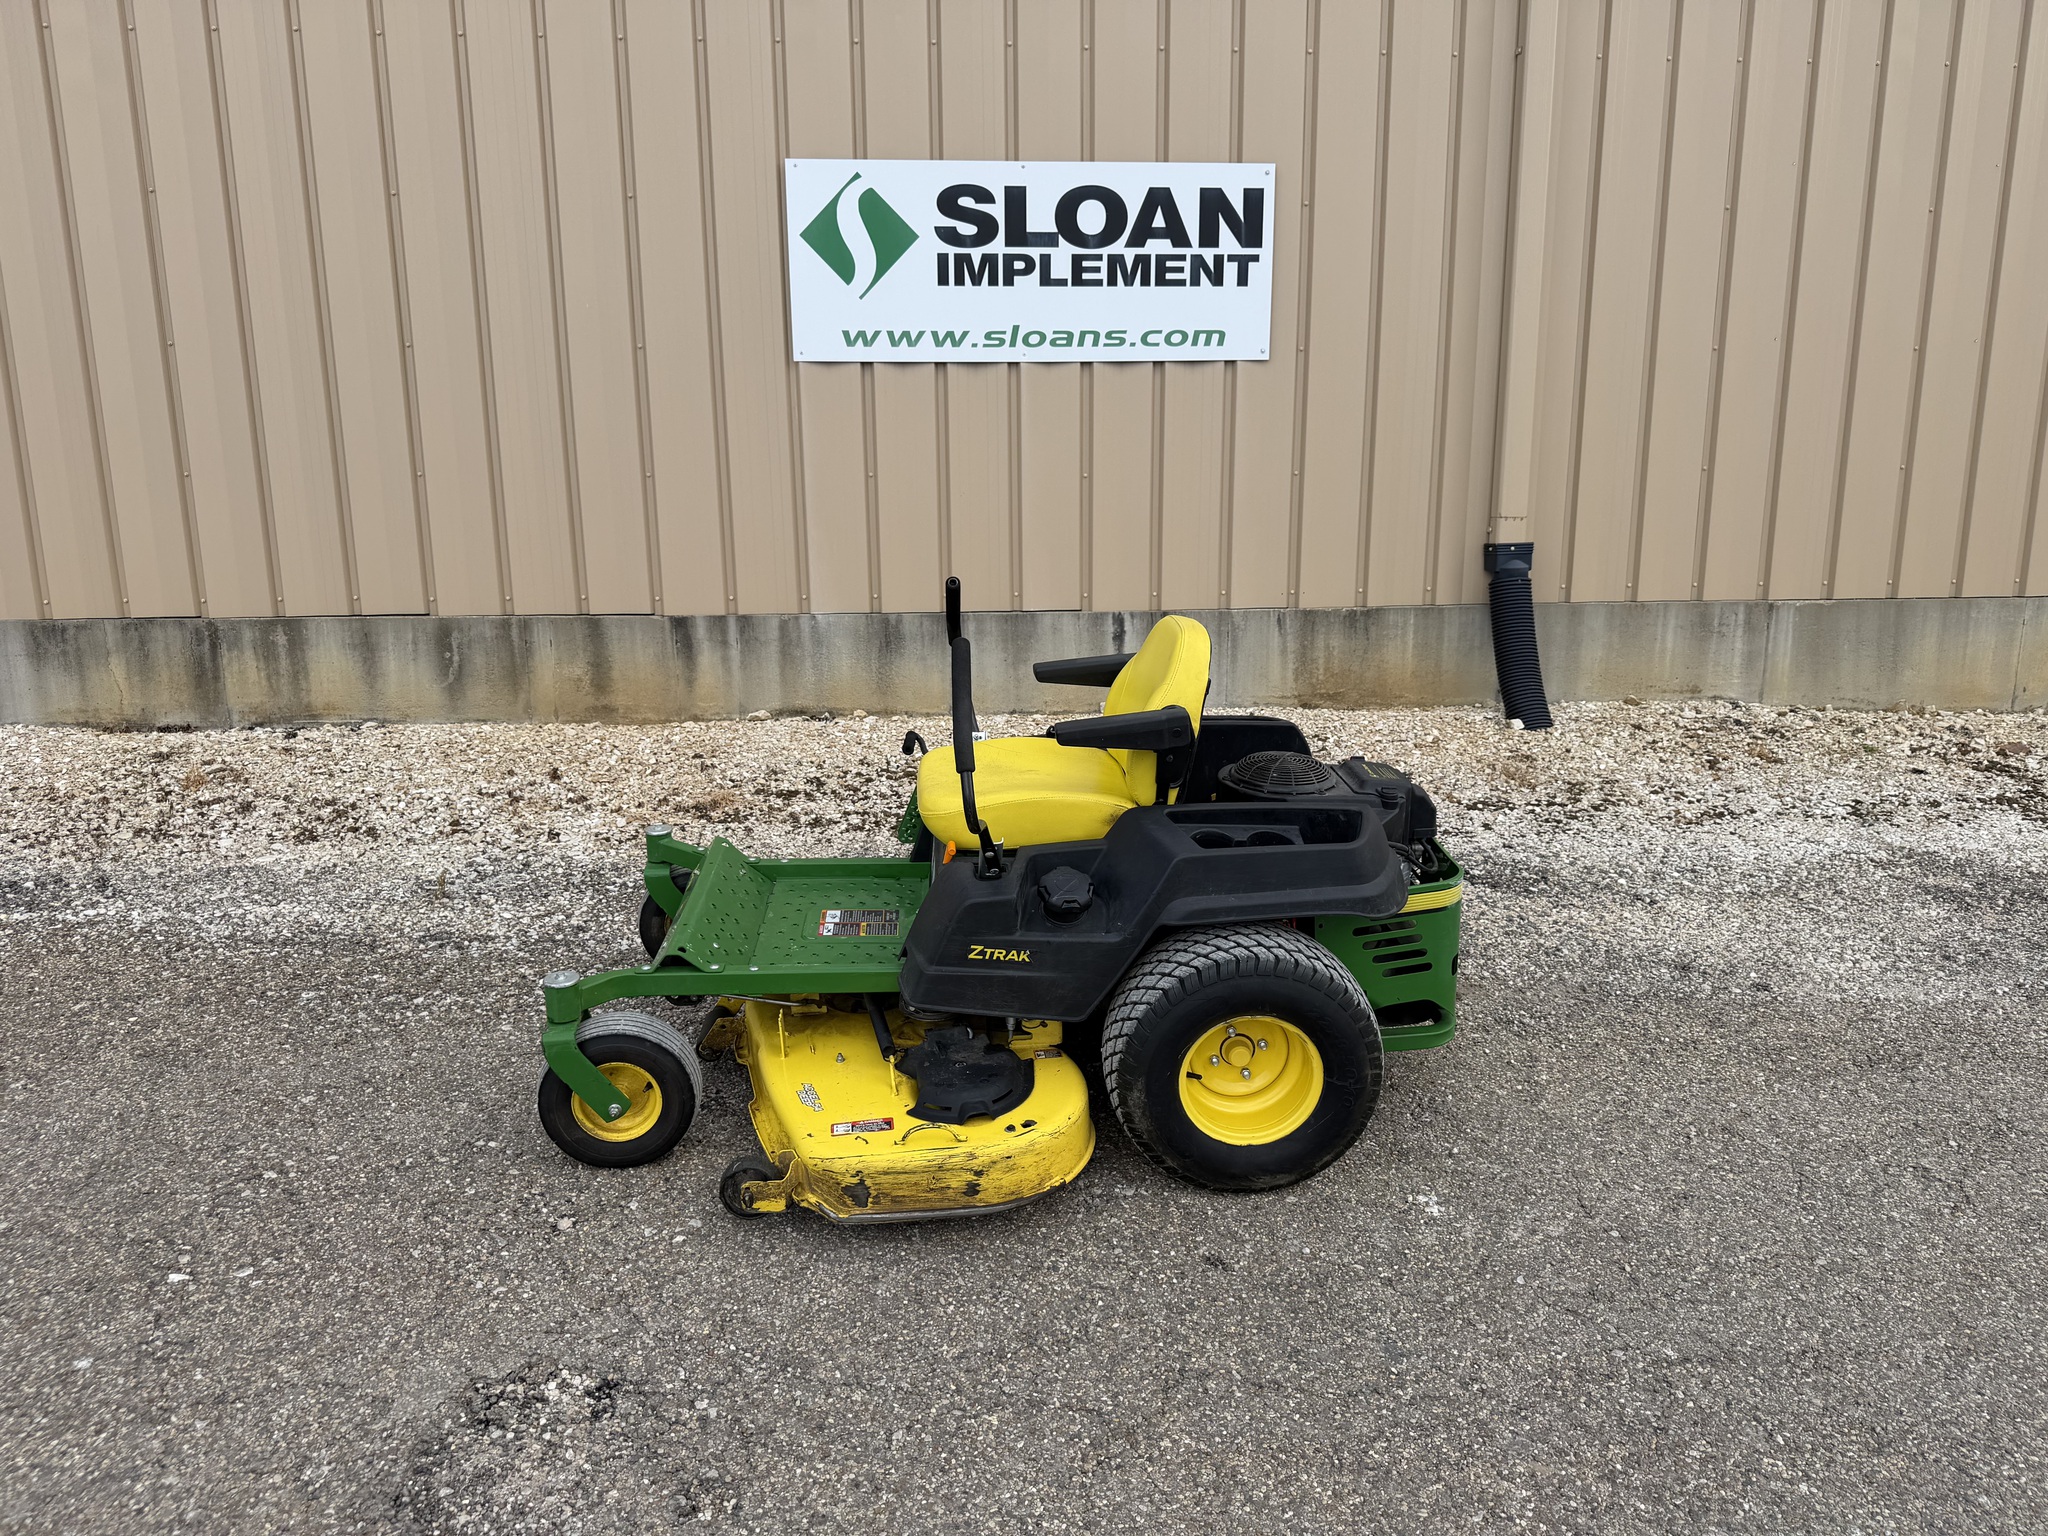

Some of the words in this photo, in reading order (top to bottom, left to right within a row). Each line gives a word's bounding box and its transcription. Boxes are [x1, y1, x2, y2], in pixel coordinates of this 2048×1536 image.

[934, 184, 1264, 249] SLOAN
[936, 253, 1260, 287] IMPLEMENT
[841, 324, 1227, 348] www.sloans.com
[967, 945, 1031, 962] ZTRAK
